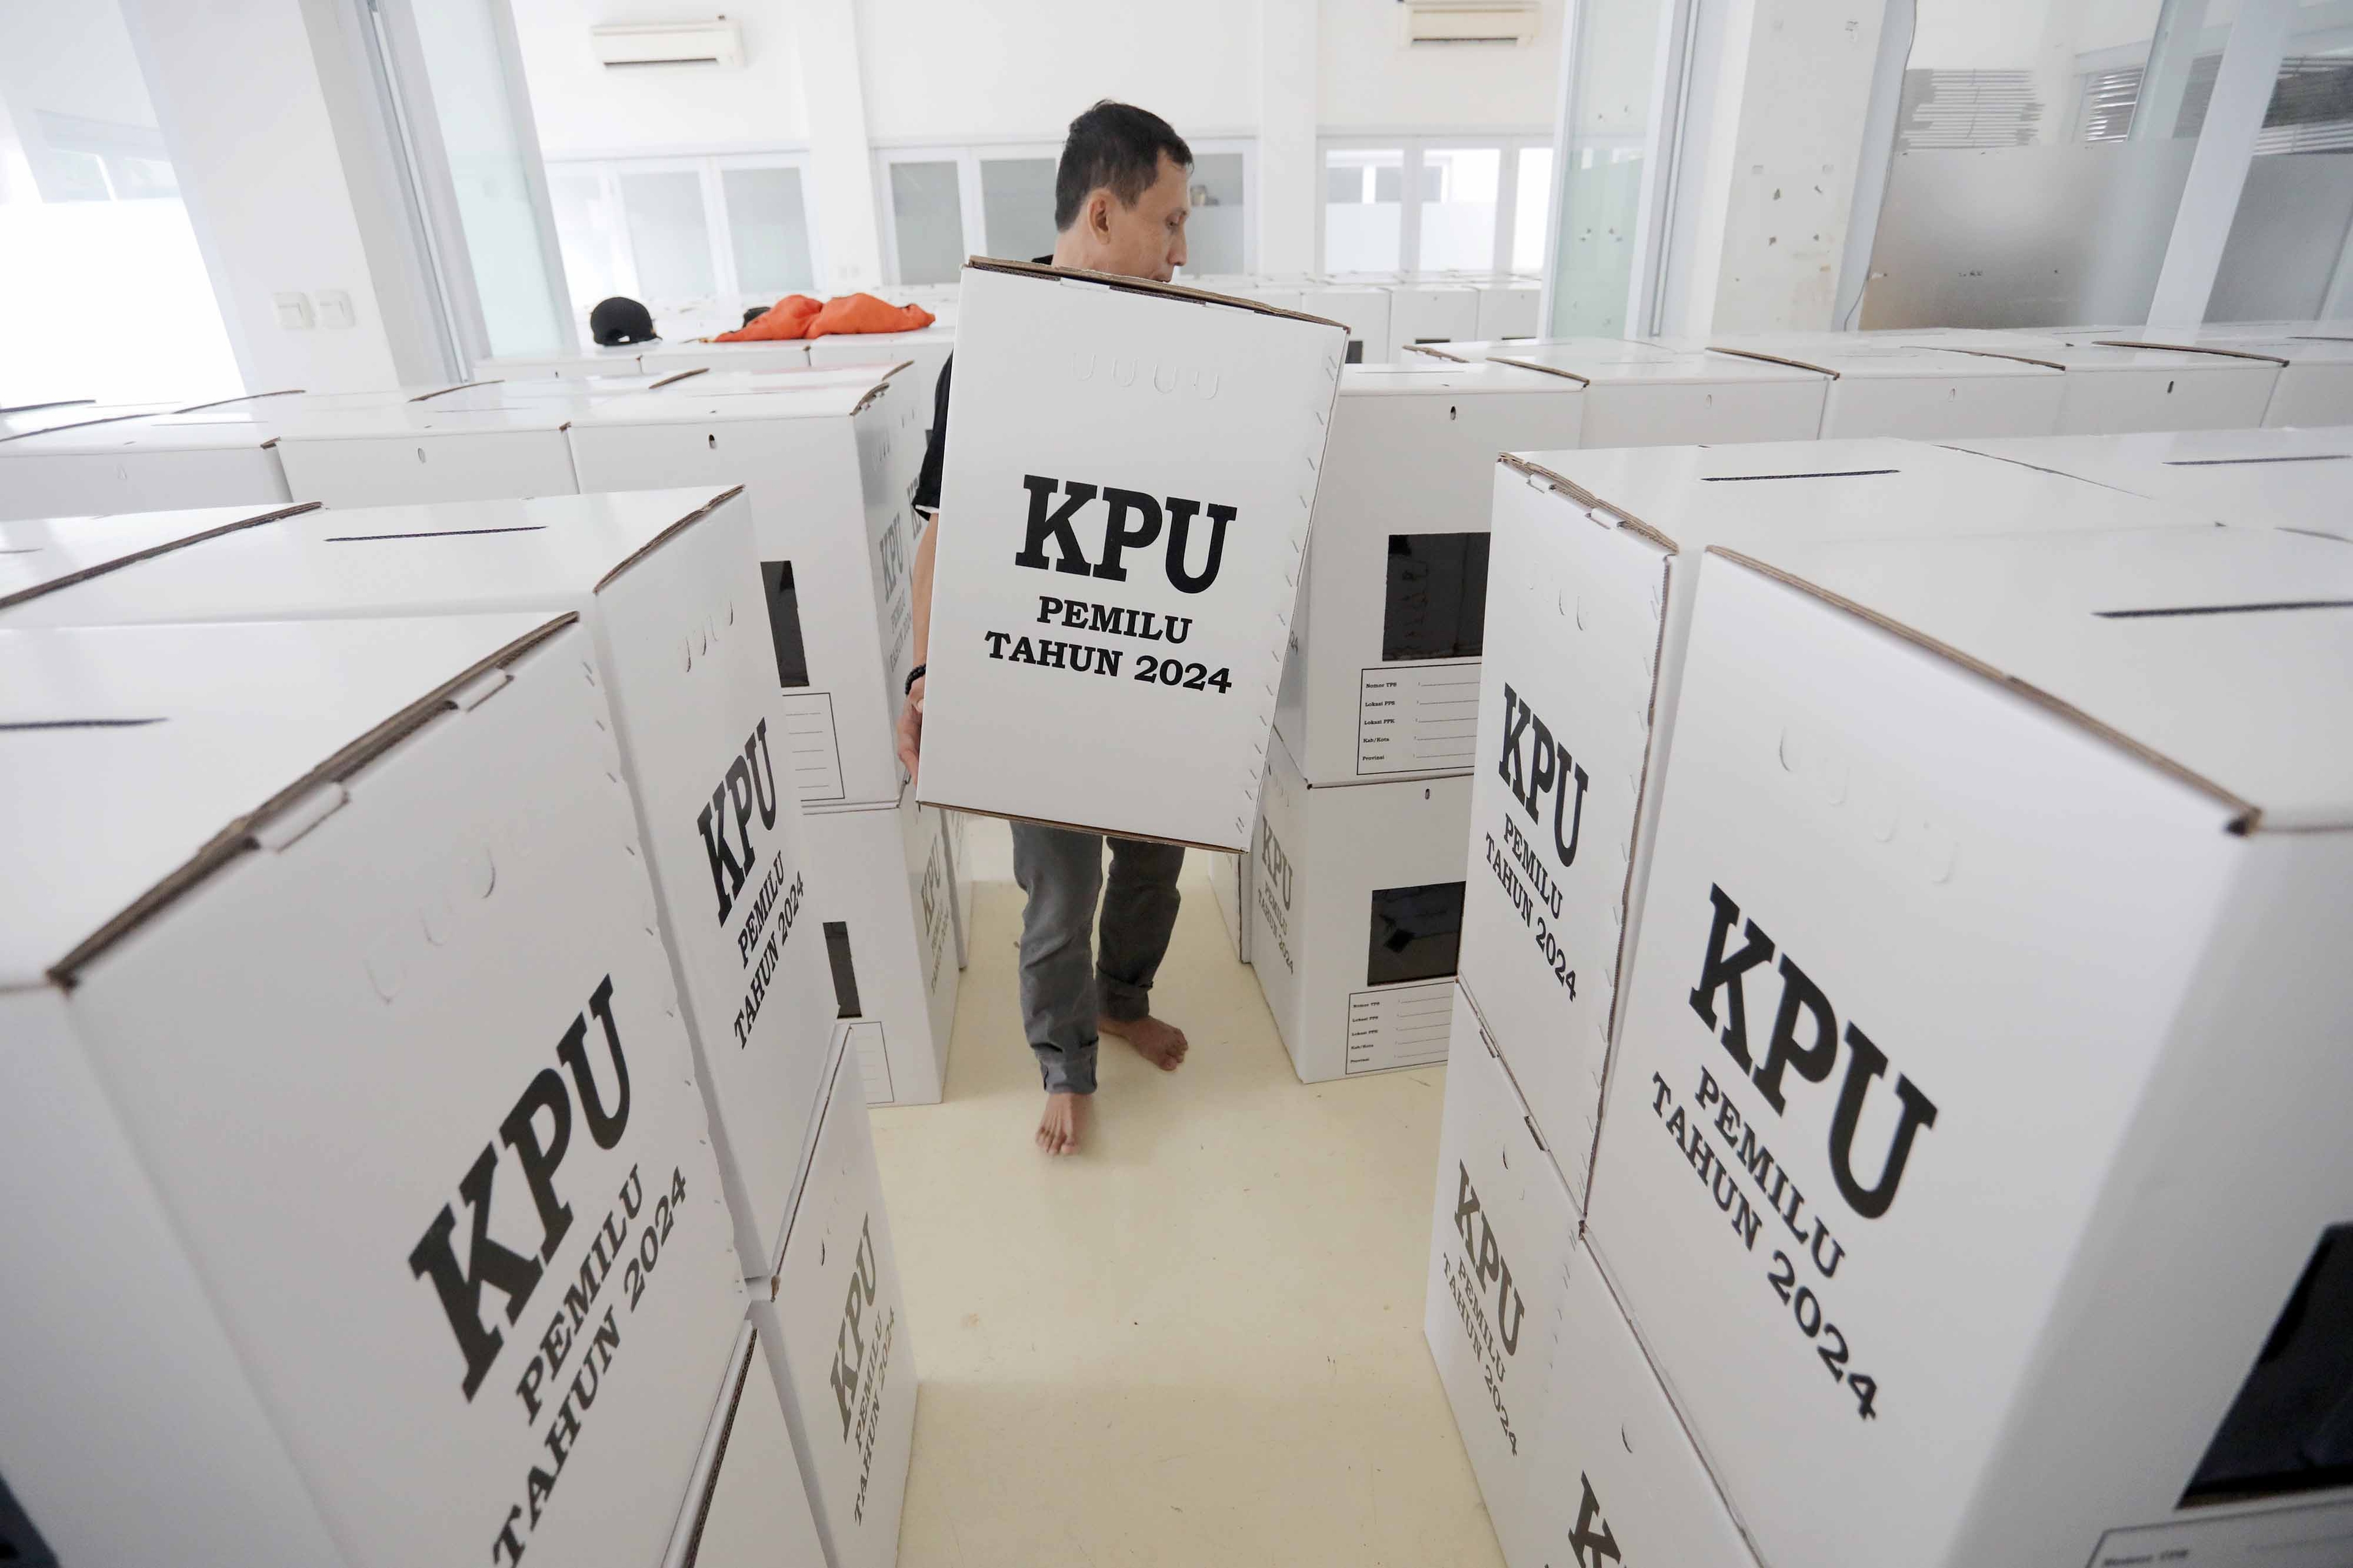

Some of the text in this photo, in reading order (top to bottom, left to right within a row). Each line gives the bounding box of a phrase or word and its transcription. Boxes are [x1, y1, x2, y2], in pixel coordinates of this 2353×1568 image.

[880, 513, 903, 604] KPU
[1015, 475, 1237, 594] KPU
[1037, 596, 1192, 643] PEMILU
[985, 631, 1232, 694] TAHUN 2024
[697, 717, 776, 928] KPU
[1262, 814, 1292, 911] KPU
[1499, 683, 1588, 867] KPU
[1504, 813, 1563, 919] PEMILU
[734, 871, 803, 1050] TAHUN 2024
[738, 850, 784, 969] PEMILU
[1486, 832, 1576, 1002] TAHUN 2024
[1689, 883, 1938, 1219] KPU
[408, 974, 630, 1403] KPU
[1455, 1159, 1525, 1356] KPU
[1653, 1075, 1877, 1420] TAHUN 2024
[1696, 1066, 1845, 1278] PEMILU
[493, 1166, 686, 1567] TAHUN 2024
[516, 1164, 642, 1426] PEMILU
[830, 1213, 876, 1444] KPU
[855, 1311, 881, 1454] PEMILU
[1444, 1254, 1517, 1456] TAHUN 2024
[1458, 1257, 1506, 1382] PEMILU
[855, 1306, 894, 1526] TAHUN 2024
